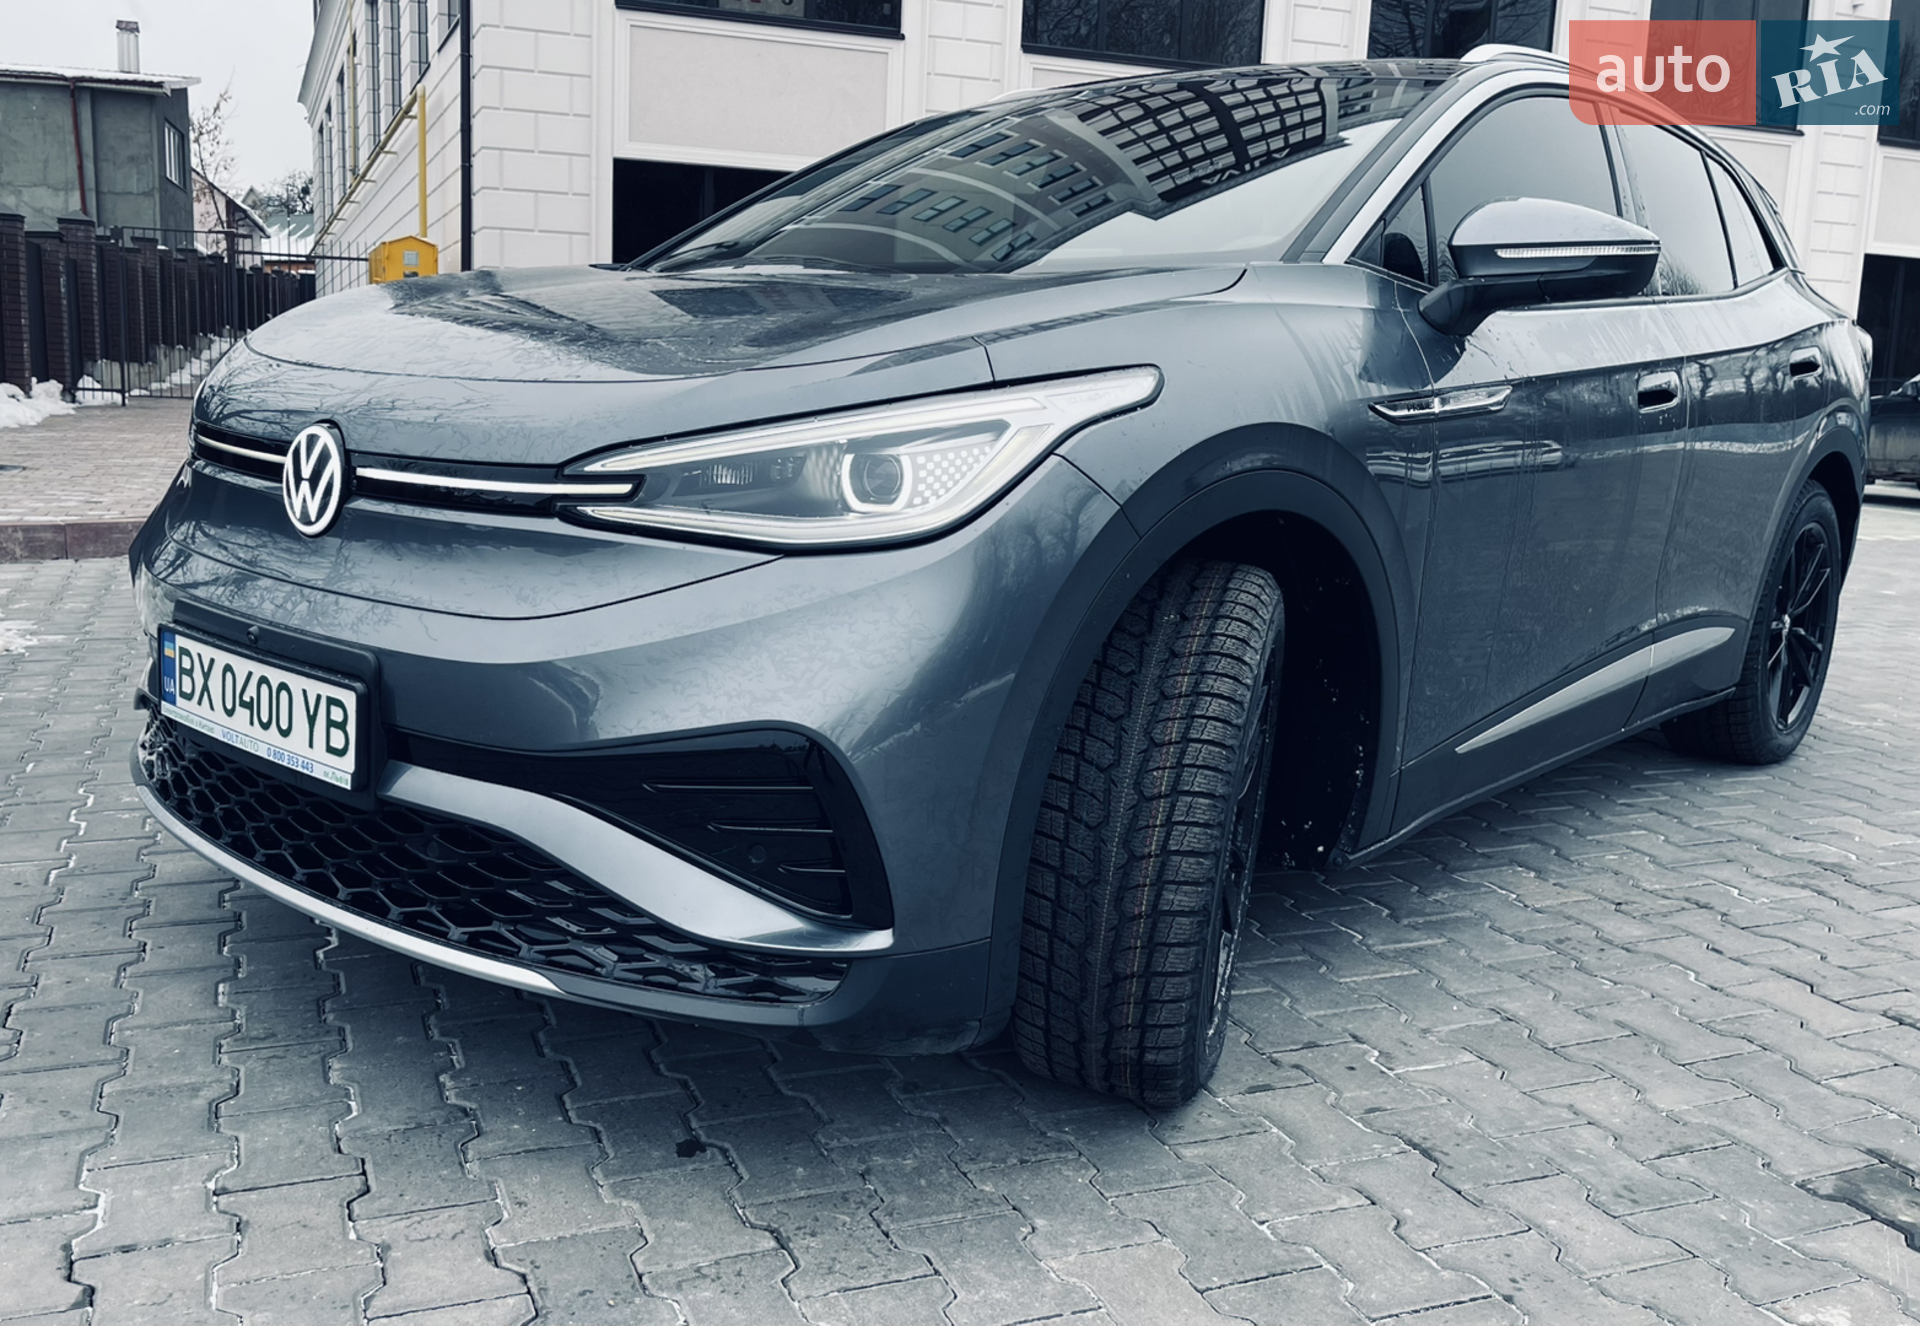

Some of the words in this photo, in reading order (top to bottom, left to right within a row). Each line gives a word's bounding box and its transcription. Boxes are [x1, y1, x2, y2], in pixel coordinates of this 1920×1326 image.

[164, 676, 175, 695] UA
[179, 646, 215, 712] BX
[222, 663, 293, 738] 0400
[302, 688, 350, 757] YB
[221, 728, 259, 752] VOLTAUTO
[267, 747, 272, 758] 0
[272, 749, 285, 763] 800
[287, 753, 299, 768] 353
[301, 757, 314, 773] 443
